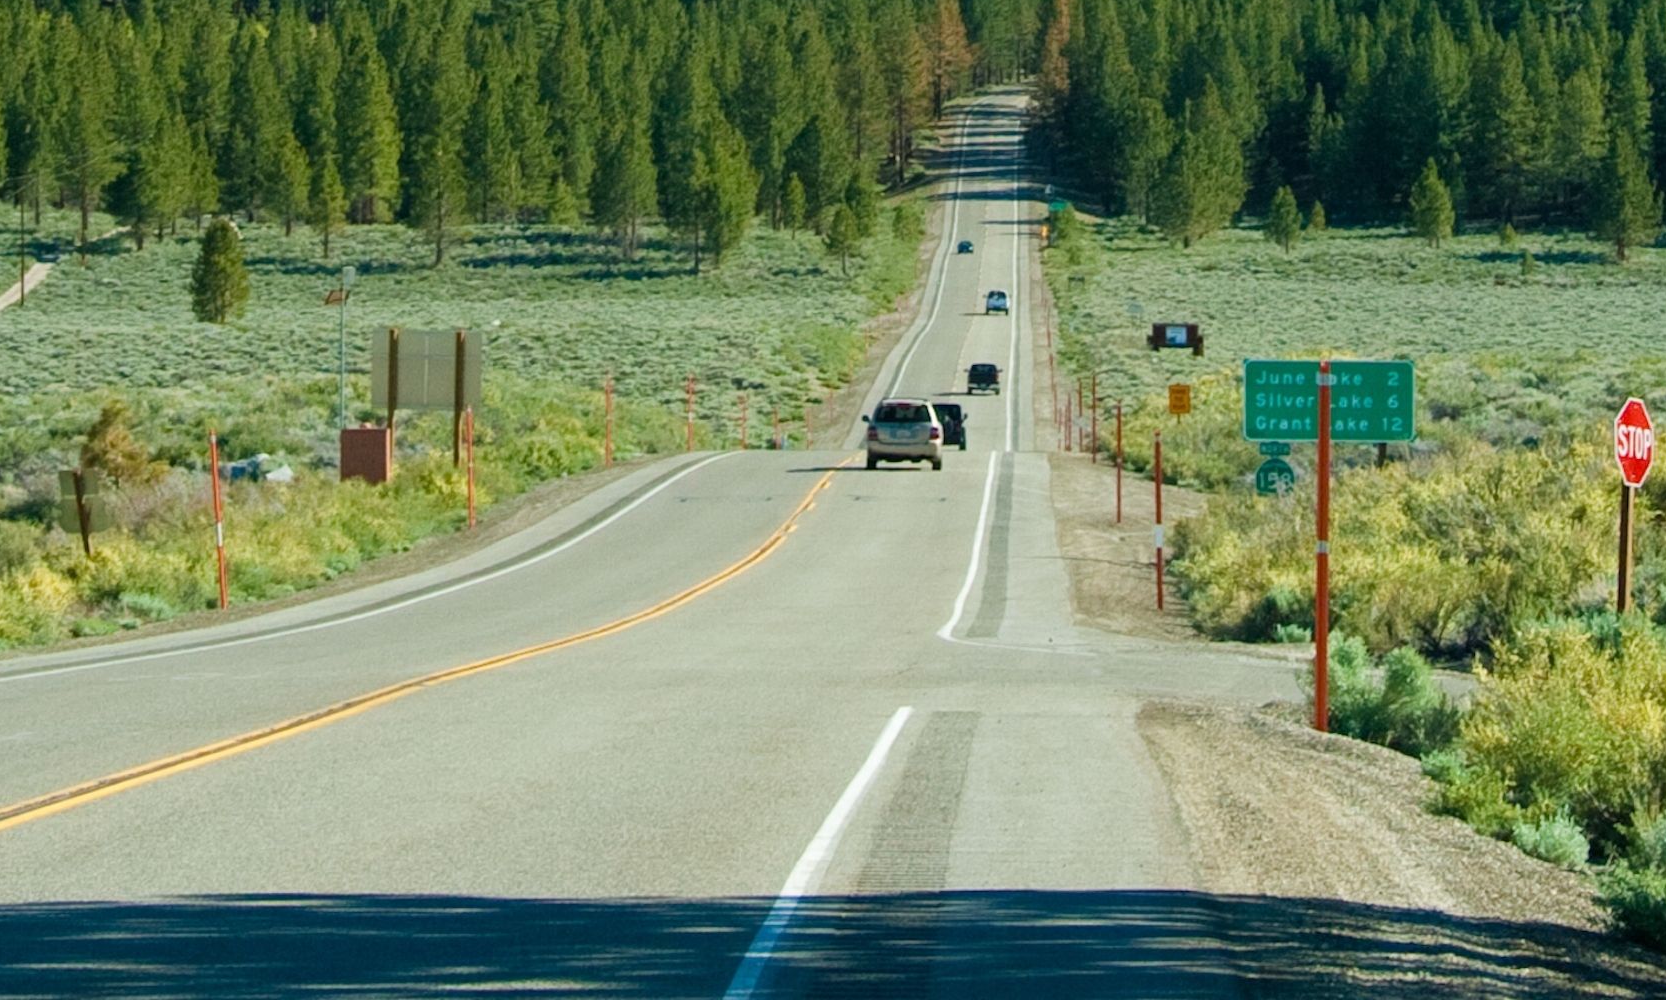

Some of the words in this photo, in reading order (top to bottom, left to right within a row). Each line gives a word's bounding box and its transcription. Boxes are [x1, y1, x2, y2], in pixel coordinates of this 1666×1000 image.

[1255, 371, 1305, 385] June
[1387, 371, 1399, 387] 2
[1255, 393, 1315, 408] Silver
[1329, 394, 1373, 408] ake
[1387, 394, 1398, 409] 6
[1255, 415, 1312, 430] Grant
[1330, 417, 1369, 431] ake
[1382, 417, 1403, 431] 12
[1617, 425, 1652, 460] STOP
